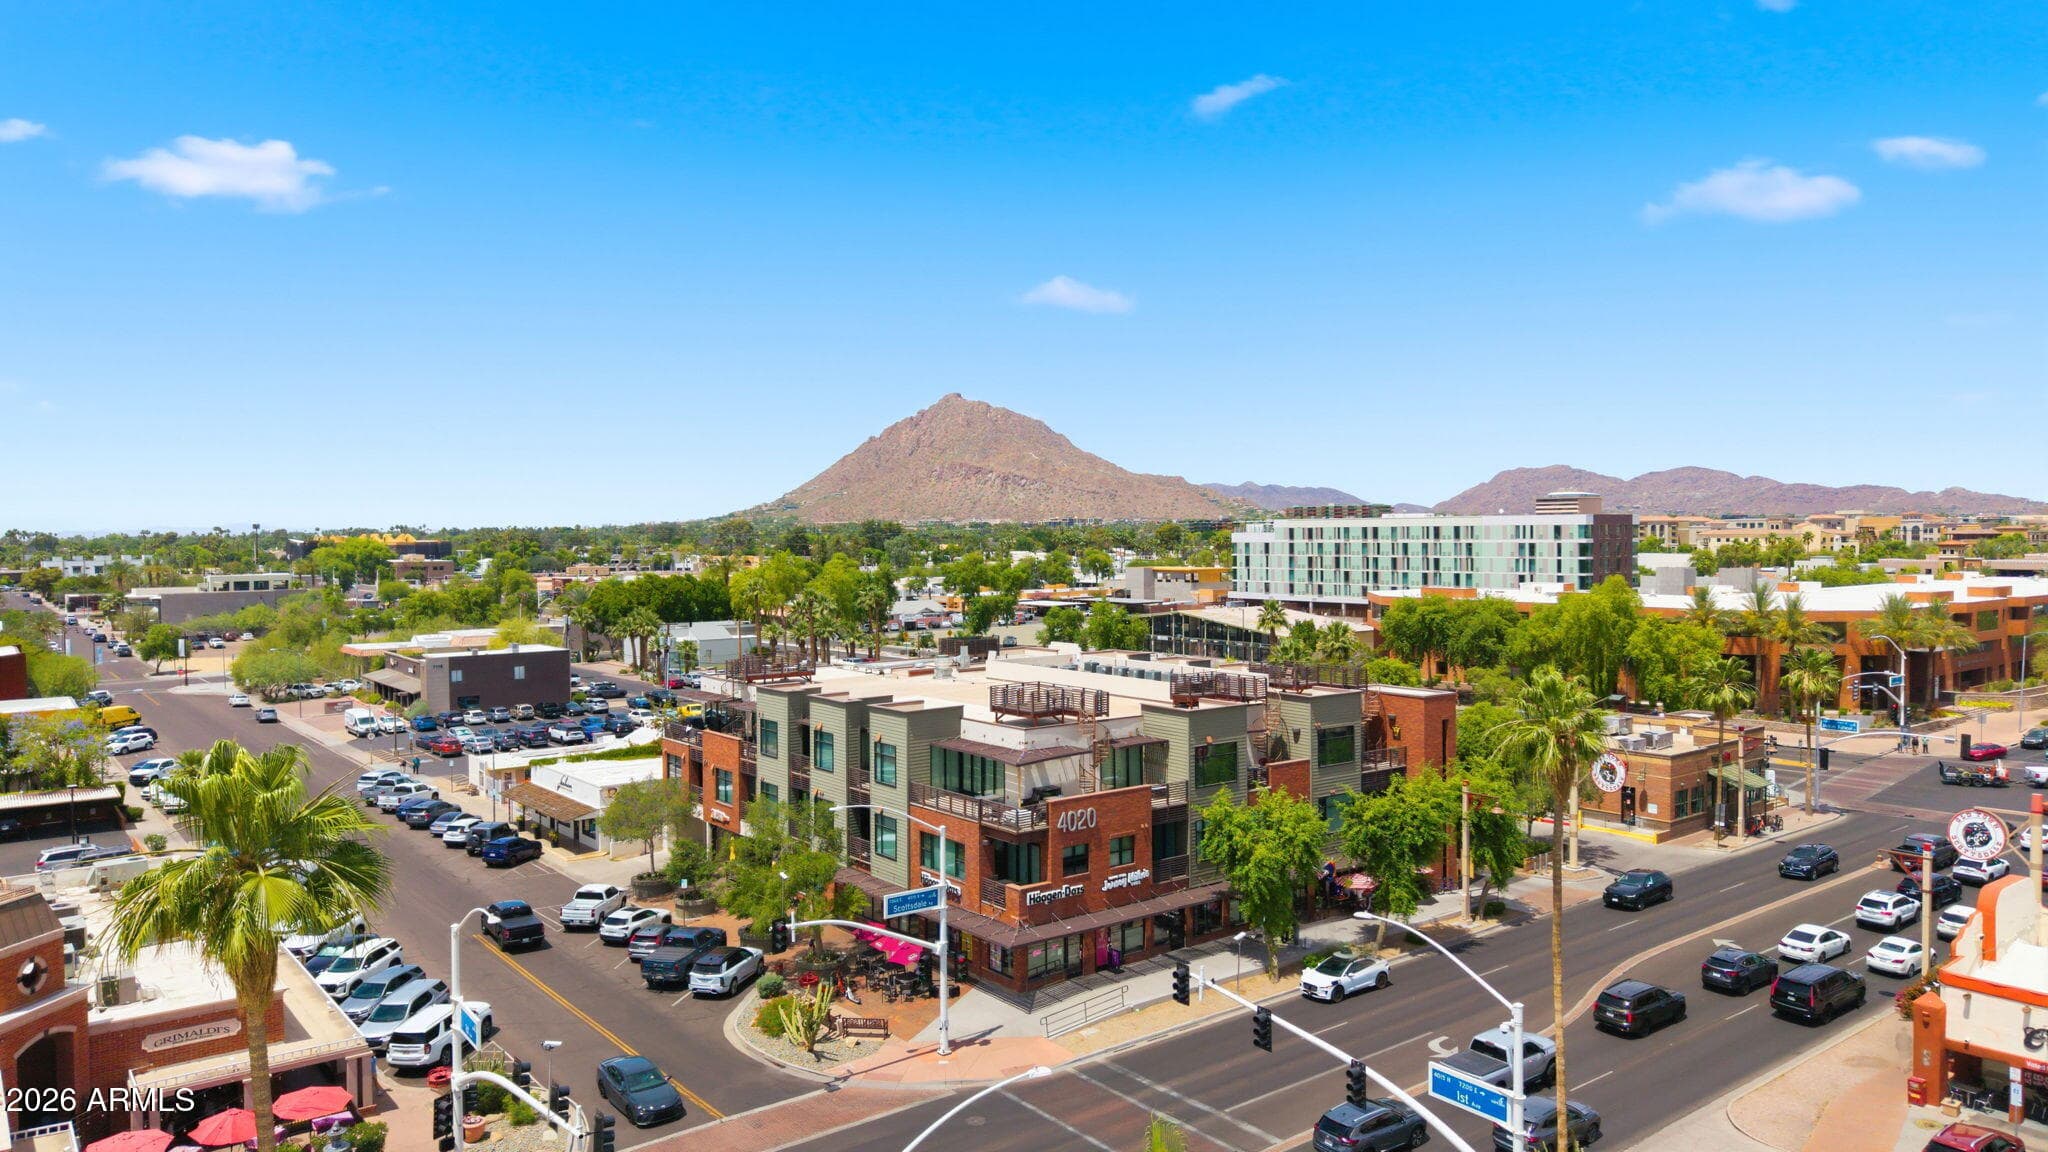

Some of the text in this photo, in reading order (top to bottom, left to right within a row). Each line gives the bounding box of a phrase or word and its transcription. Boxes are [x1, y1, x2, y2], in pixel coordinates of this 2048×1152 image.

[1057, 807, 1097, 832] 4020
[893, 901, 927, 912] Scottsdale
[153, 1026, 231, 1048] GRIMALDI'S
[1457, 1090, 1469, 1105] 1st
